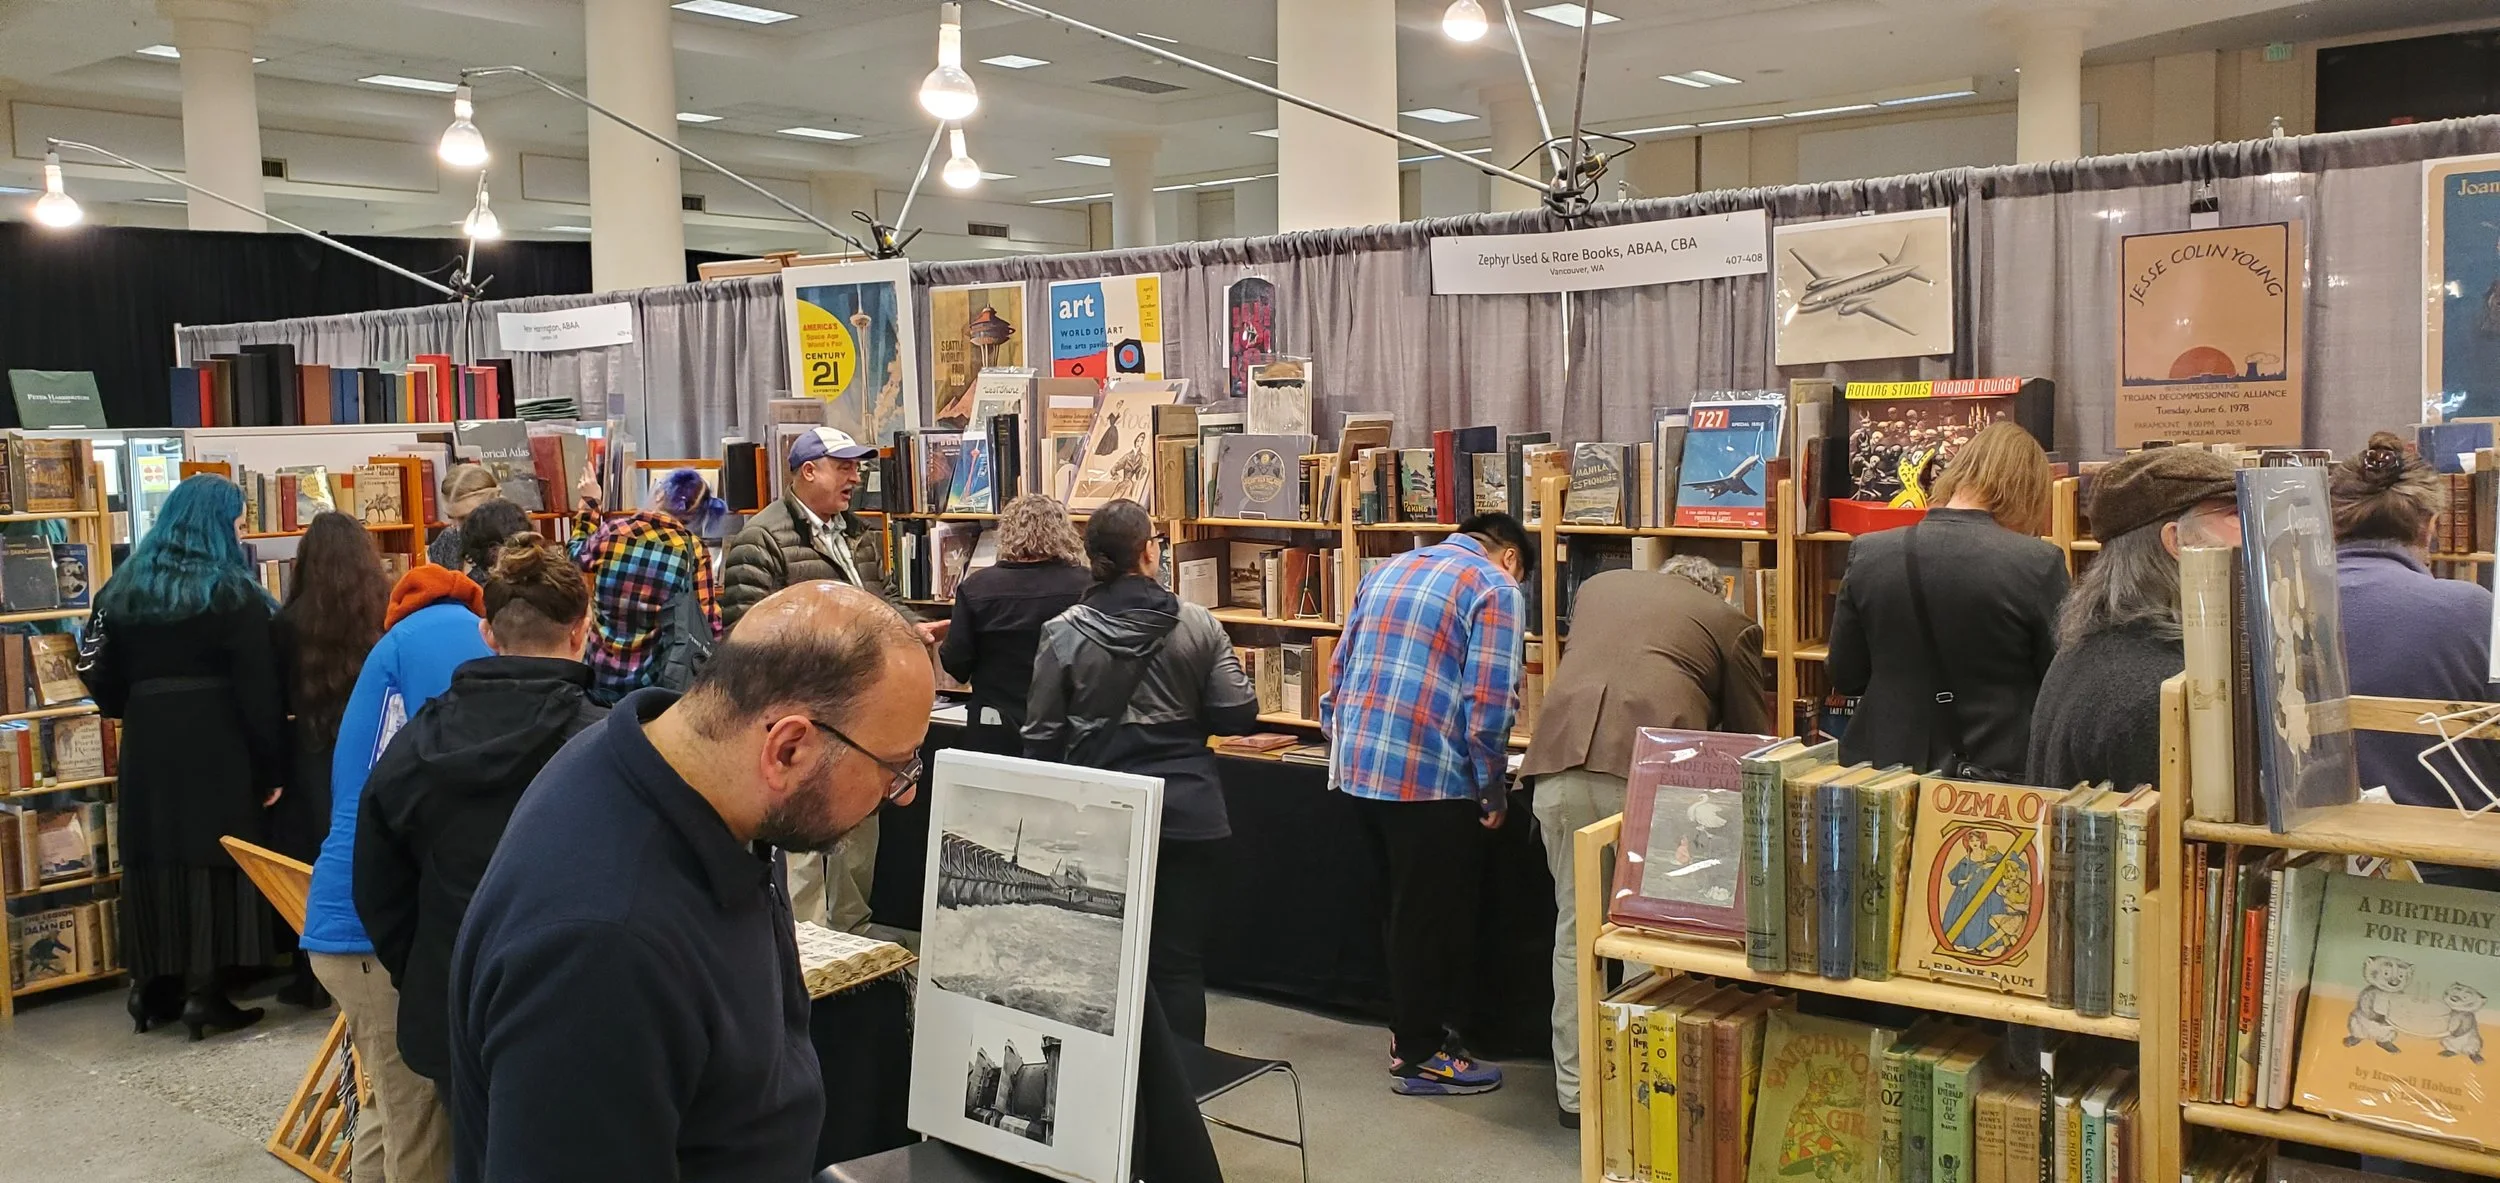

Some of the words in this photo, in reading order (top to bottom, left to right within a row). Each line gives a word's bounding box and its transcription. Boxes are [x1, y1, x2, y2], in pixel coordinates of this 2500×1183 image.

[1478, 253, 1510, 268] Zephyr
[1512, 252, 1538, 265] Used
[1541, 252, 1550, 264] &
[1552, 250, 1579, 263] Rare
[1582, 246, 1623, 261] Books,
[1627, 241, 1667, 257] ABAA,
[1670, 237, 1697, 251] CBA
[1725, 252, 1763, 266] 407-408
[1550, 266, 1589, 276] Vancouver,
[1590, 264, 1604, 273] WA
[2129, 259, 2167, 306] JESSE
[2171, 243, 2229, 265] COLIN
[2231, 248, 2283, 297] YOUNG
[1059, 294, 1095, 319] art
[562, 321, 580, 330] ABAA
[803, 323, 838, 331] AMERICA'S
[1061, 328, 1091, 337] WORLD
[1093, 328, 1104, 336] OF
[1107, 326, 1123, 335] ART
[1075, 342, 1087, 350] arts
[1089, 342, 1114, 351] pavilion
[805, 352, 846, 360] CENTURY
[812, 361, 839, 386] 21
[951, 364, 965, 374] FAIR
[1848, 384, 1887, 397] ROLLING
[1892, 383, 1929, 396] STONES
[1934, 381, 1975, 394] VOODOO
[1978, 378, 2017, 392] LOUNGE
[2160, 392, 2240, 400] DECOMMISSIONING
[2244, 390, 2287, 398] ALLIANCE
[2156, 406, 2192, 415] Tuesday,
[2194, 406, 2216, 414] June
[2230, 404, 2250, 412] 1978
[1697, 410, 1724, 428] 727
[508, 447, 530, 458] Atlas
[1576, 463, 1609, 477] MANILA
[1572, 472, 1617, 490] ESPIONAGE
[2241, 662, 2251, 695] Dickens
[1660, 773, 1700, 787] FAIRY
[1932, 783, 2012, 821] OZMA
[2358, 898, 2372, 913] A
[2378, 898, 2497, 930] BIRTHDAY
[24, 920, 73, 936] DAMNED
[2364, 922, 2407, 942] FOR
[1918, 960, 1930, 970] L.
[1990, 971, 2035, 988] BAUM
[1631, 1023, 1648, 1035] GIA
[1881, 1071, 1905, 1083] ROAD
[2355, 1066, 2368, 1080] by
[2421, 1078, 2463, 1096] Hoban
[1881, 1088, 1904, 1107] OZ
[1942, 1097, 1959, 1107] CITY
[1943, 1112, 1956, 1122] OZ
[2069, 1121, 2076, 1138] GO
